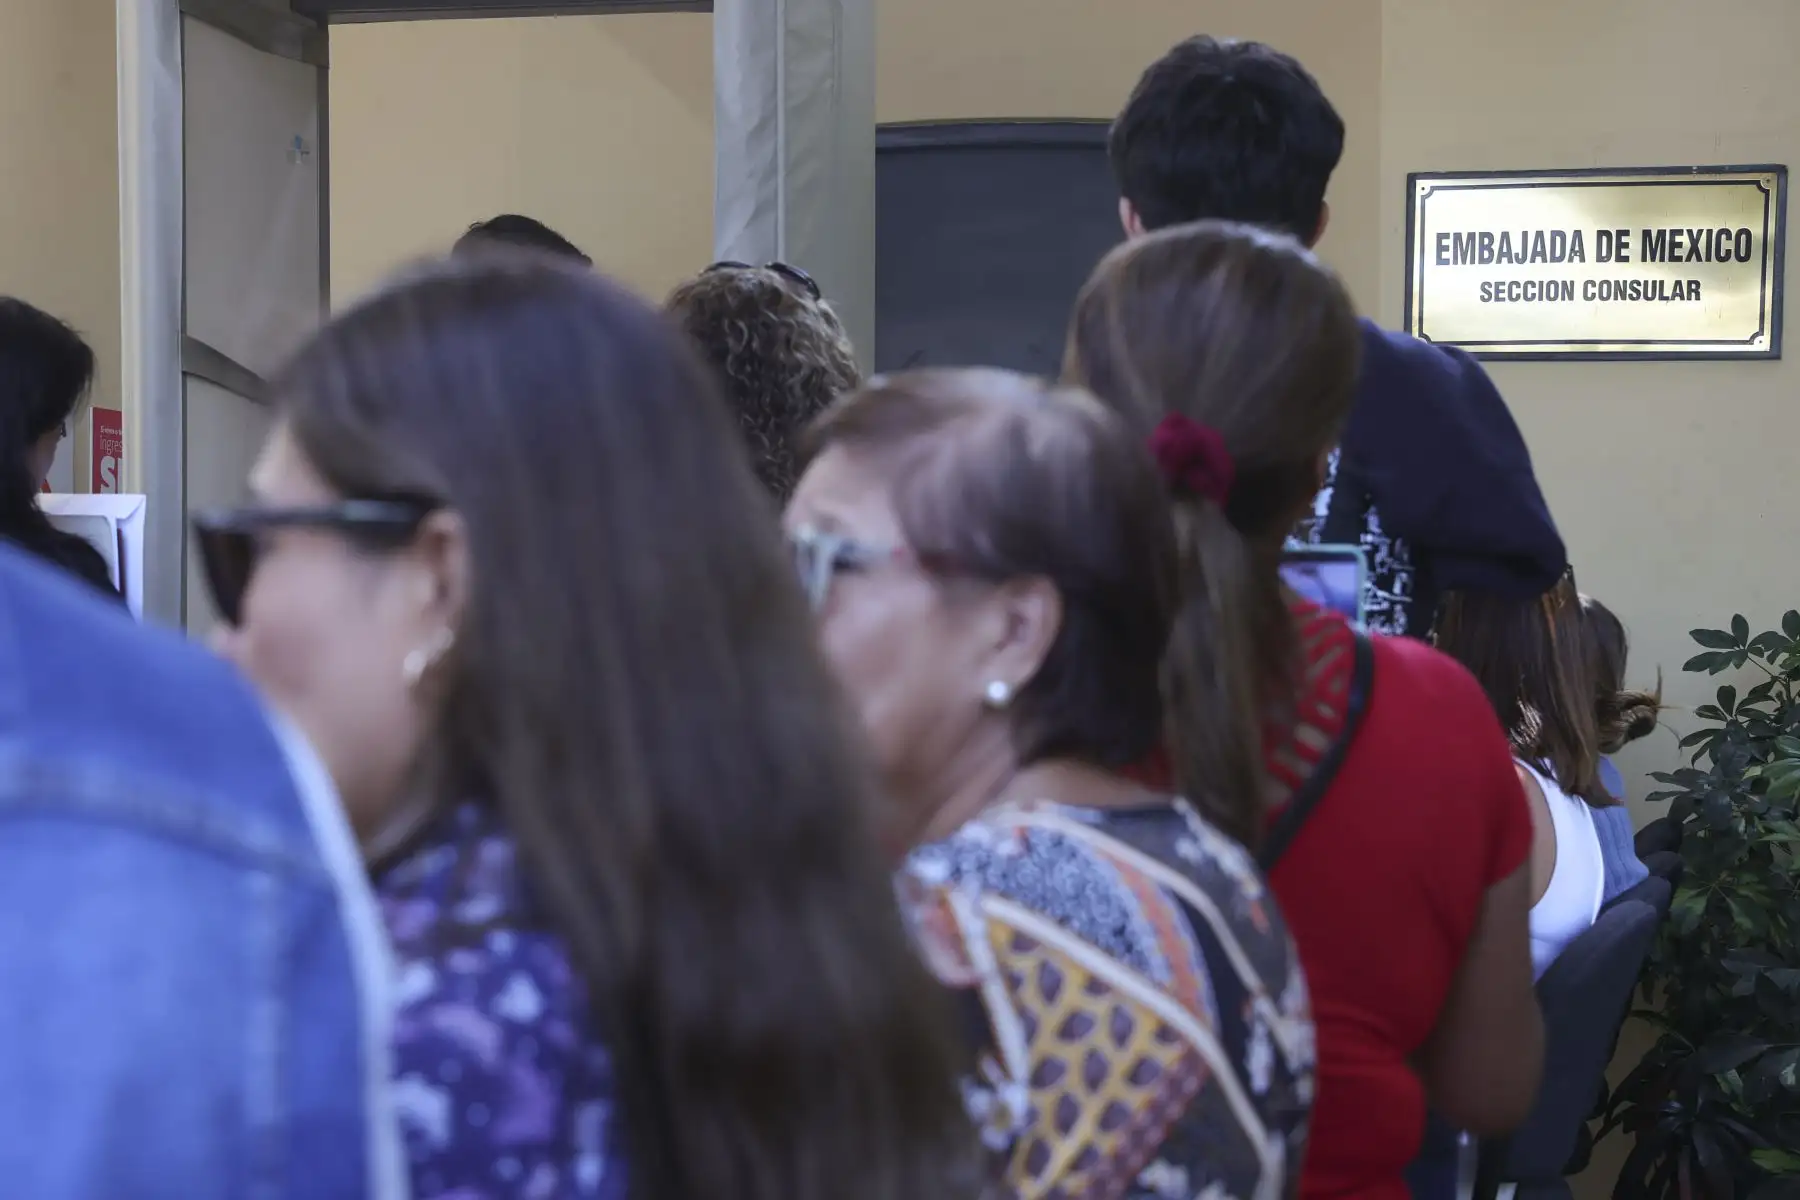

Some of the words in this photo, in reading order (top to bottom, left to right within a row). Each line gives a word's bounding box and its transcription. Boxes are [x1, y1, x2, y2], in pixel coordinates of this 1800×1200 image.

[1436, 229, 1586, 265] EMBAJADA
[1595, 229, 1630, 263] DE
[1641, 227, 1753, 263] MEXICO
[1480, 280, 1575, 302] SECCION
[1583, 279, 1701, 302] CONSULAR
